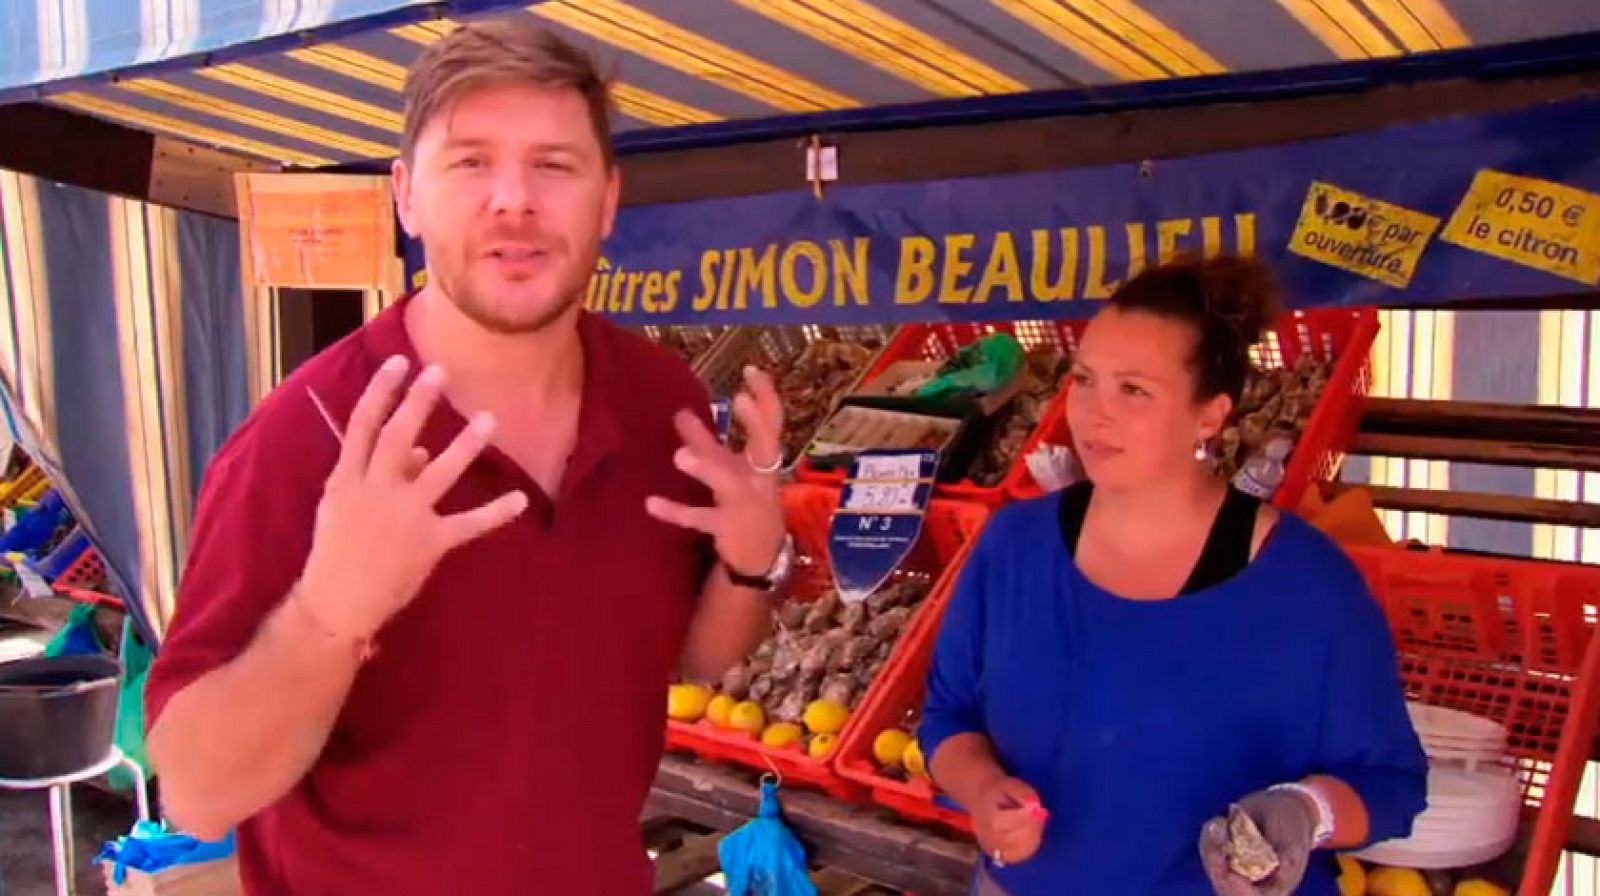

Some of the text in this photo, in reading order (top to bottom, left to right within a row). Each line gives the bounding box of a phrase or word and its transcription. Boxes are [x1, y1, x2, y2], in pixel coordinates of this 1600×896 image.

[1496, 187, 1585, 227] 0,50 €
[1304, 232, 1403, 273] ouverture
[1382, 224, 1423, 246] par
[1467, 214, 1578, 265] le citron
[692, 237, 870, 311] SIMON
[880, 516, 892, 530] 3
